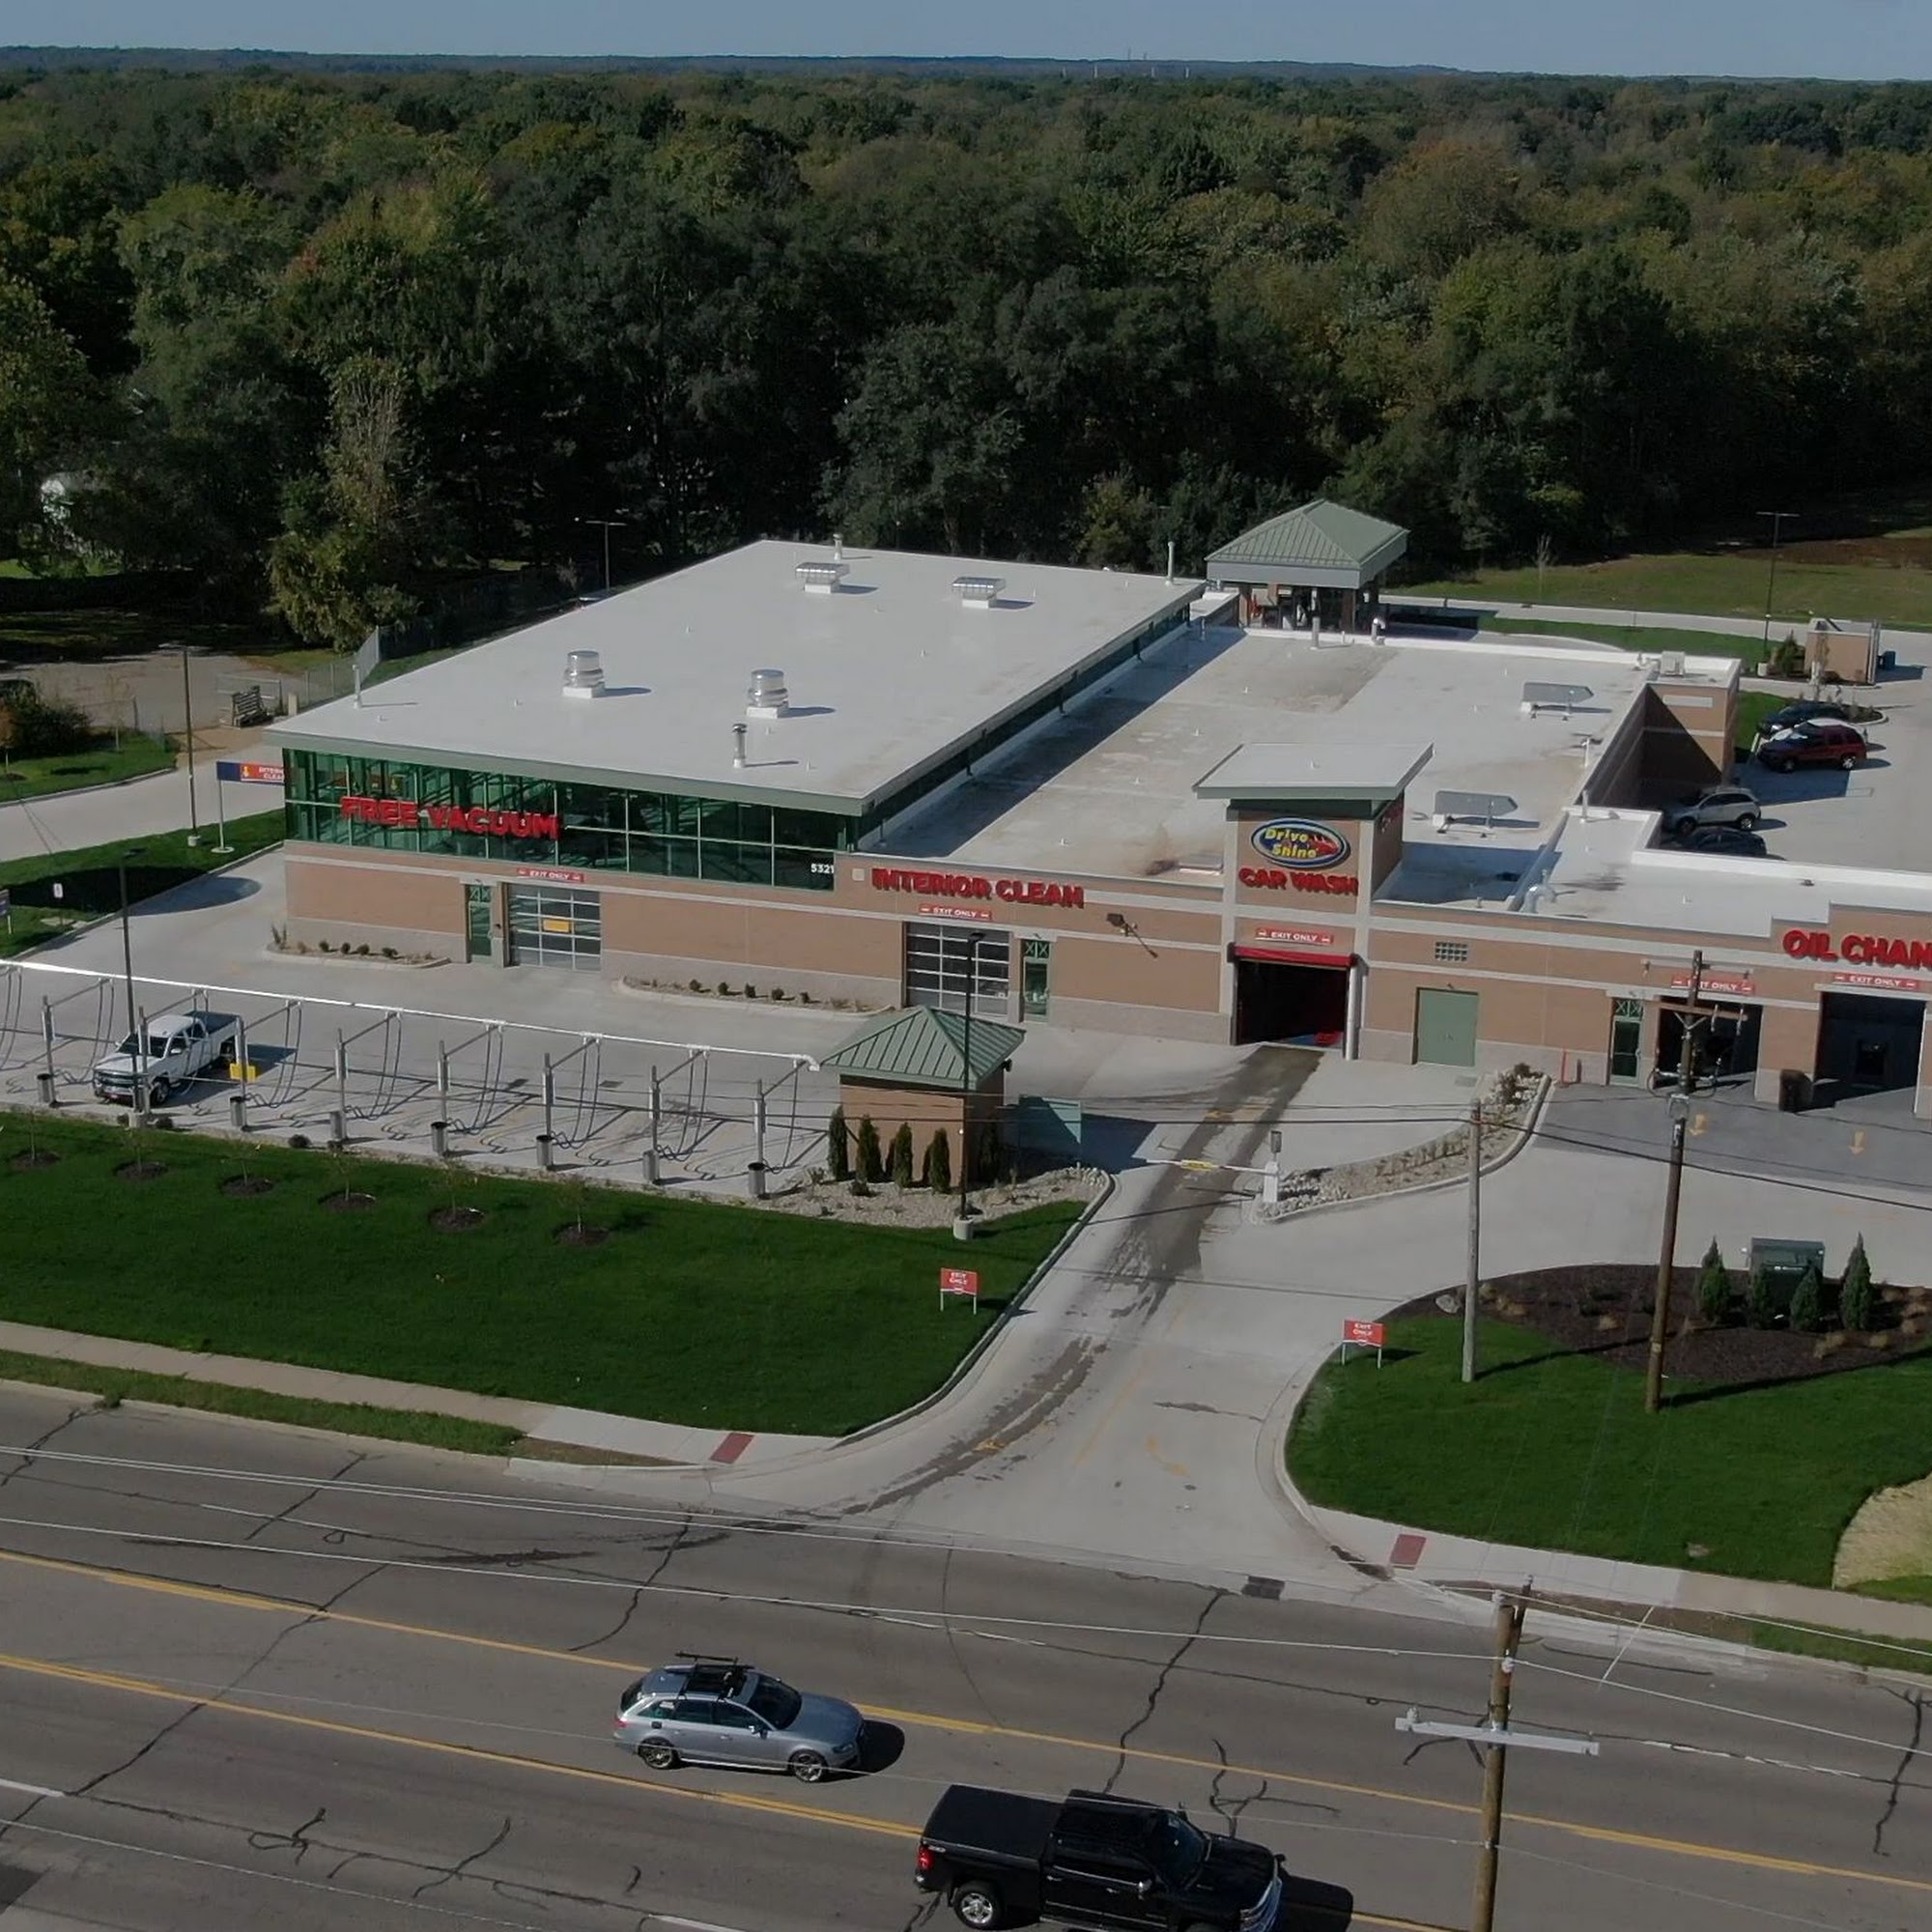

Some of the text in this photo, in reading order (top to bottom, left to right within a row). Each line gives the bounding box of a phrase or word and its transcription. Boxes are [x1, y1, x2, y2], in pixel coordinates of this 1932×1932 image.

[341, 796, 560, 839] FREE VACUUM
[811, 863, 834, 873] 5321
[1238, 867, 1359, 896] CAR WASH
[871, 868, 1085, 909] INTERIOR CLEAN
[933, 907, 978, 918] EXIT ONLY
[1270, 931, 1318, 942] EXIT ONLY
[1782, 929, 1838, 962] OIL
[1711, 981, 1737, 991] ONLY
[1849, 976, 1901, 986] EXIT ONLY
